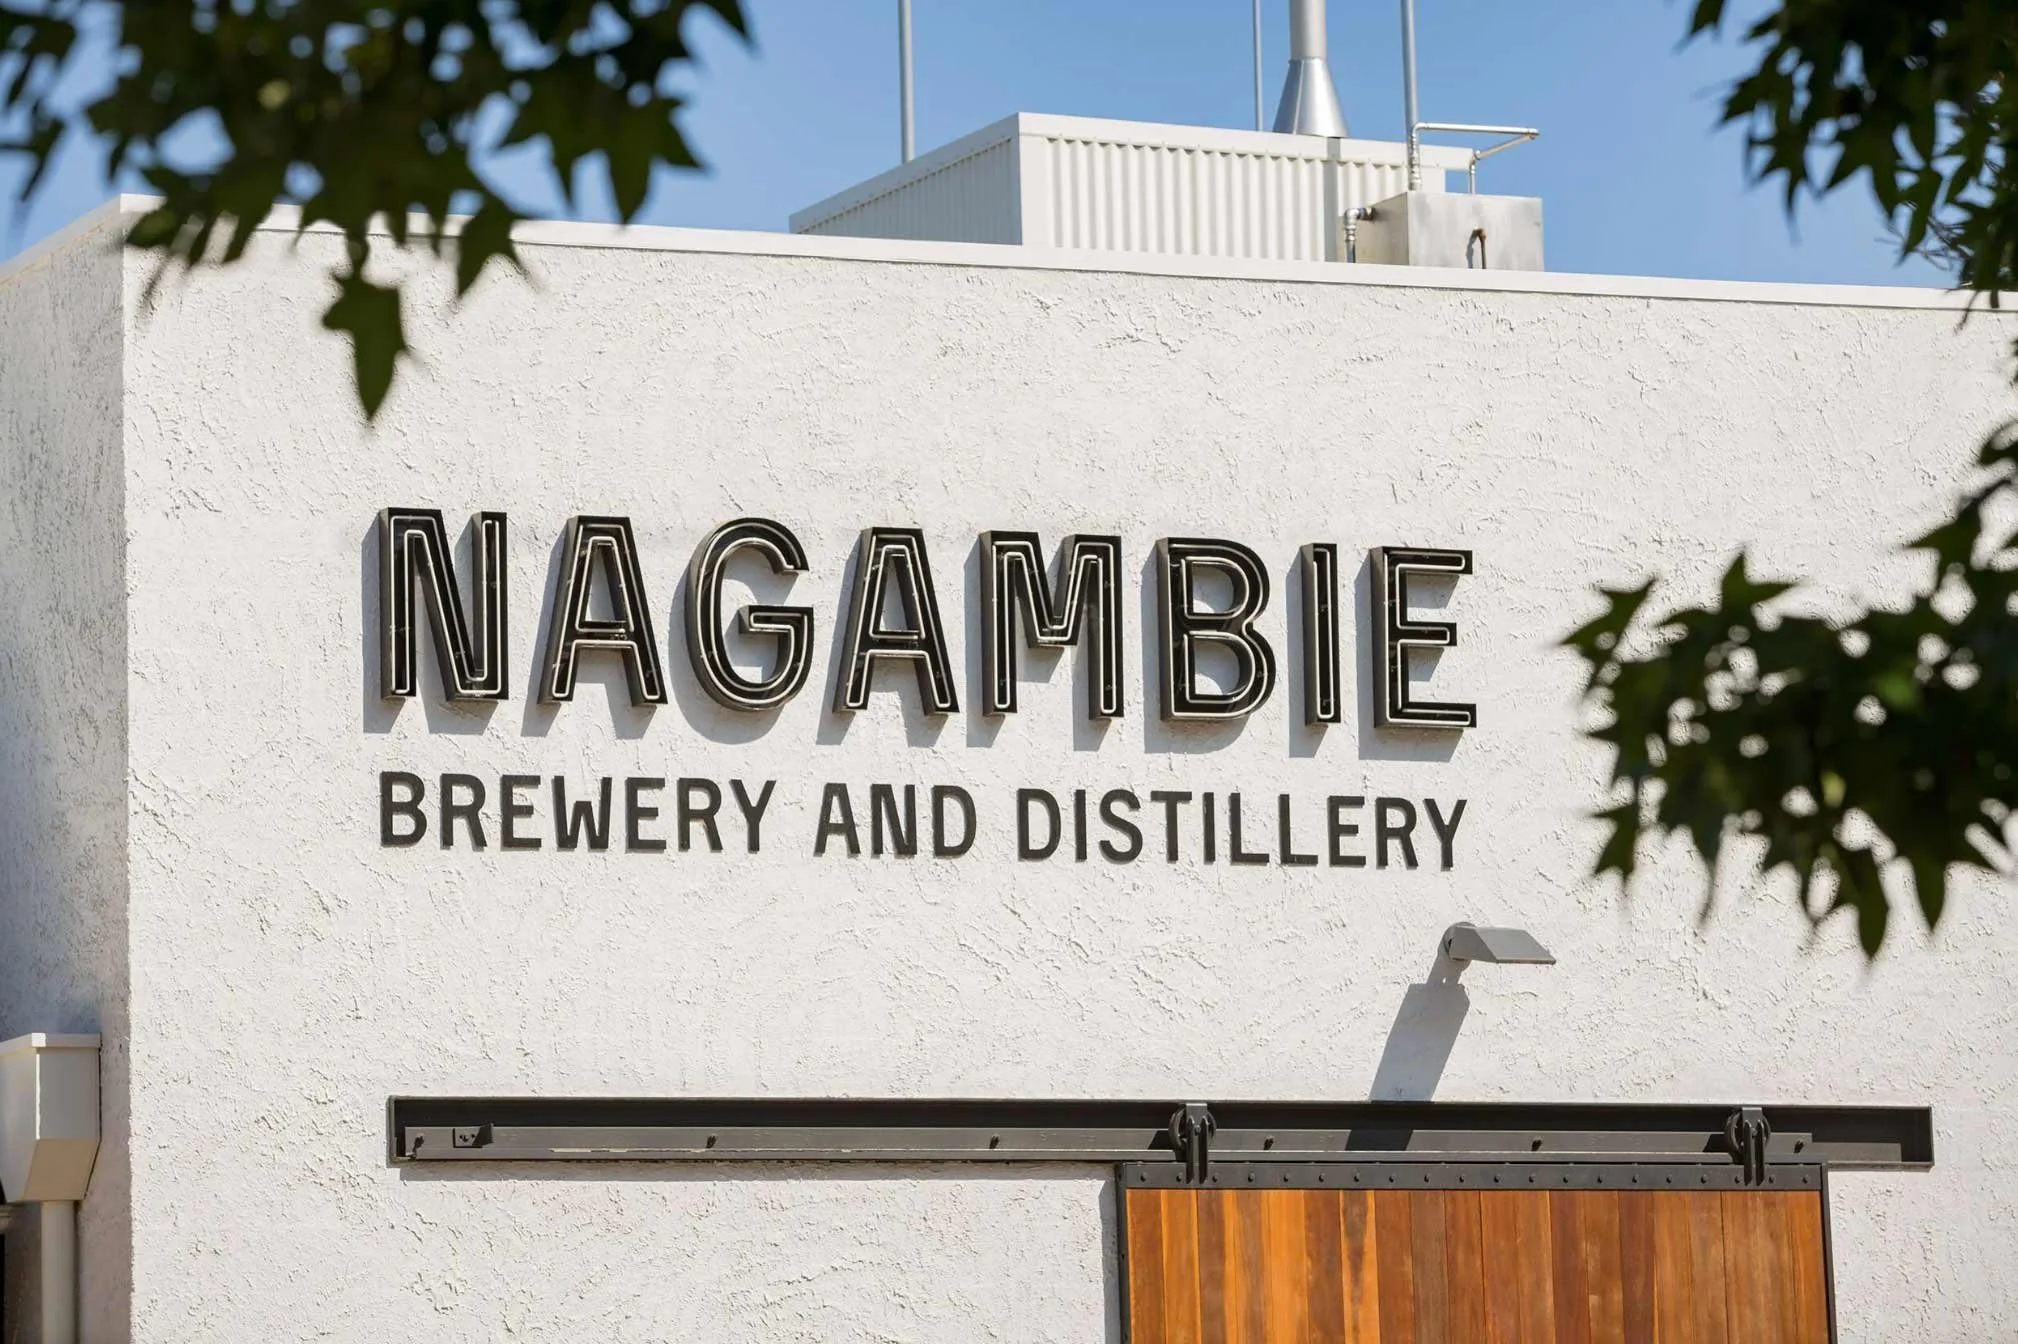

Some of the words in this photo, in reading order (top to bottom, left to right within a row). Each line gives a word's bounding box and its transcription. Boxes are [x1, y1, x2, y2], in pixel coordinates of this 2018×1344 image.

[376, 506, 1477, 732] NAGAMBIE
[381, 772, 774, 851] BREWERY
[815, 784, 976, 860] AND
[1018, 789, 1466, 869] DISTILLERY
